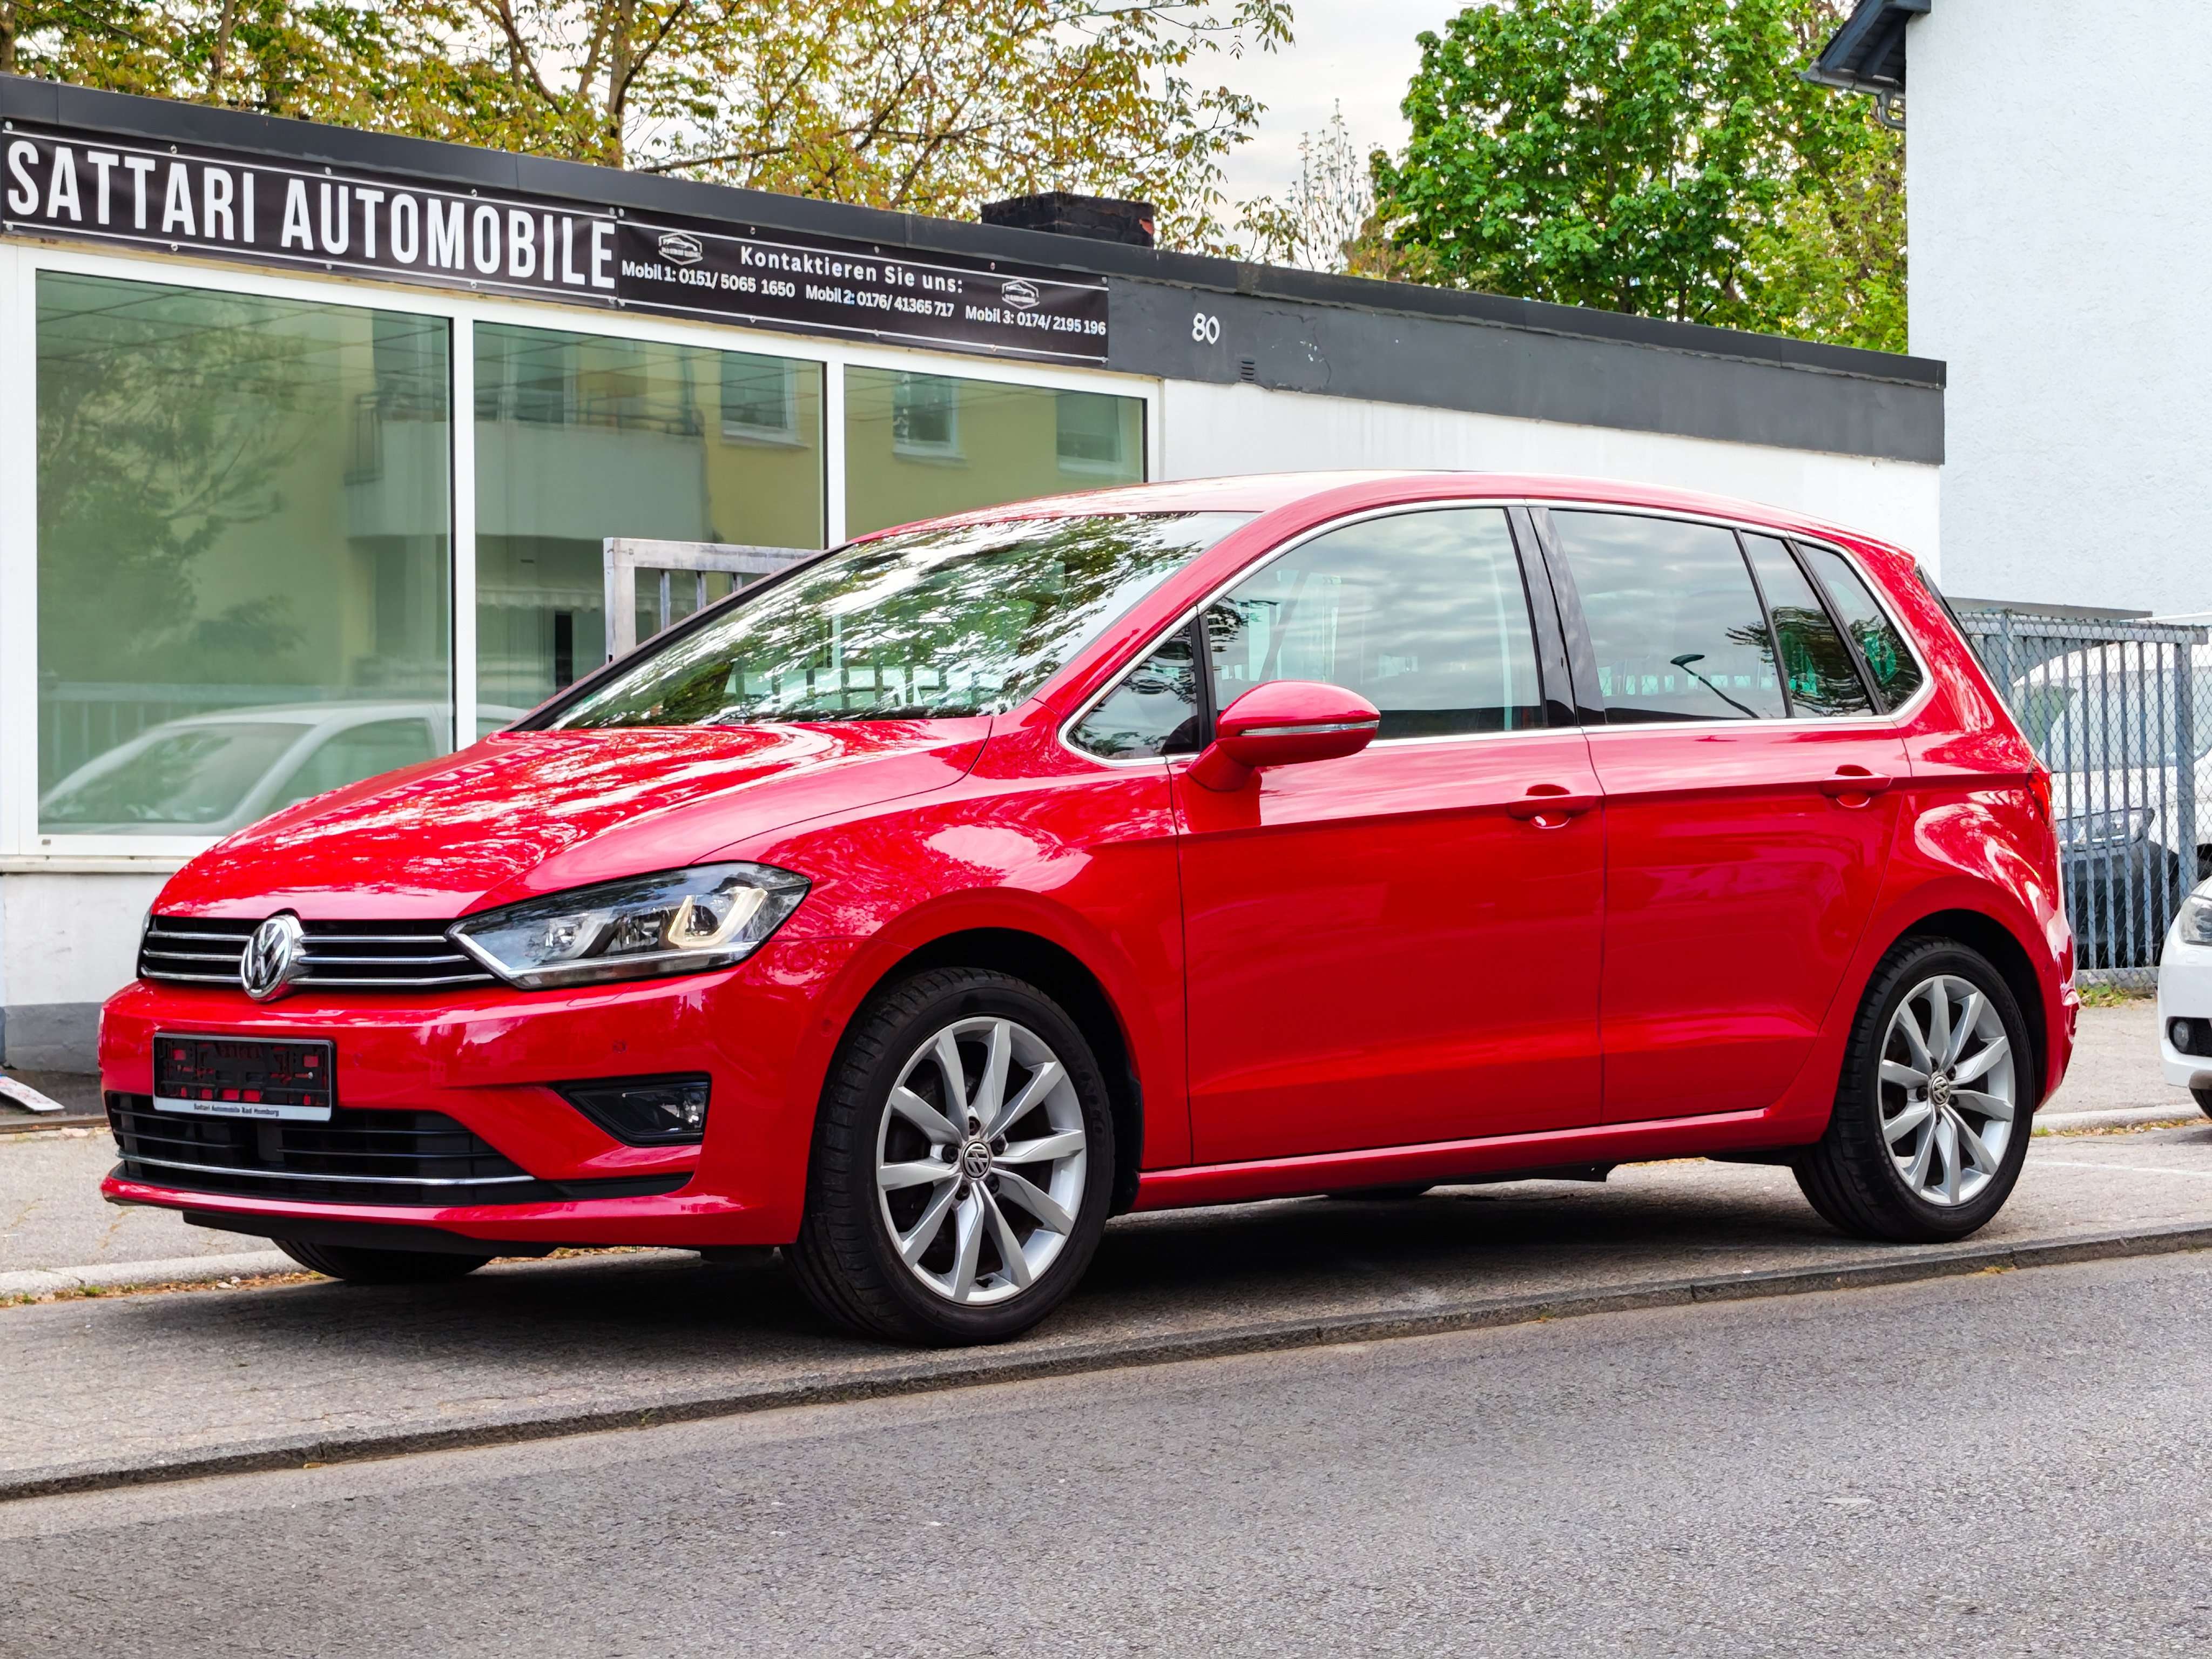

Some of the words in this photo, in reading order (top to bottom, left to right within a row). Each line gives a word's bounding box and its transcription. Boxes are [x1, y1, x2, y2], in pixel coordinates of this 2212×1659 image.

[6, 140, 254, 242] SATTARI
[281, 179, 616, 288] AUTOMOBILE
[622, 260, 663, 280] Mobil
[721, 273, 756, 293] 5065
[761, 279, 795, 298] 1650
[741, 246, 876, 282] Kontaktieren
[885, 266, 915, 287] Sie
[922, 274, 962, 294] uns:
[806, 284, 842, 303] Mobil
[857, 291, 893, 311] 0176/
[894, 296, 932, 314] 41365
[934, 301, 954, 317] 717
[966, 305, 1000, 323] Mobil
[1003, 310, 1014, 324] 3:
[1017, 312, 1051, 330] 0174/
[1053, 316, 1081, 332] 2195
[1084, 320, 1106, 335] 196
[1192, 313, 1220, 345] 80
